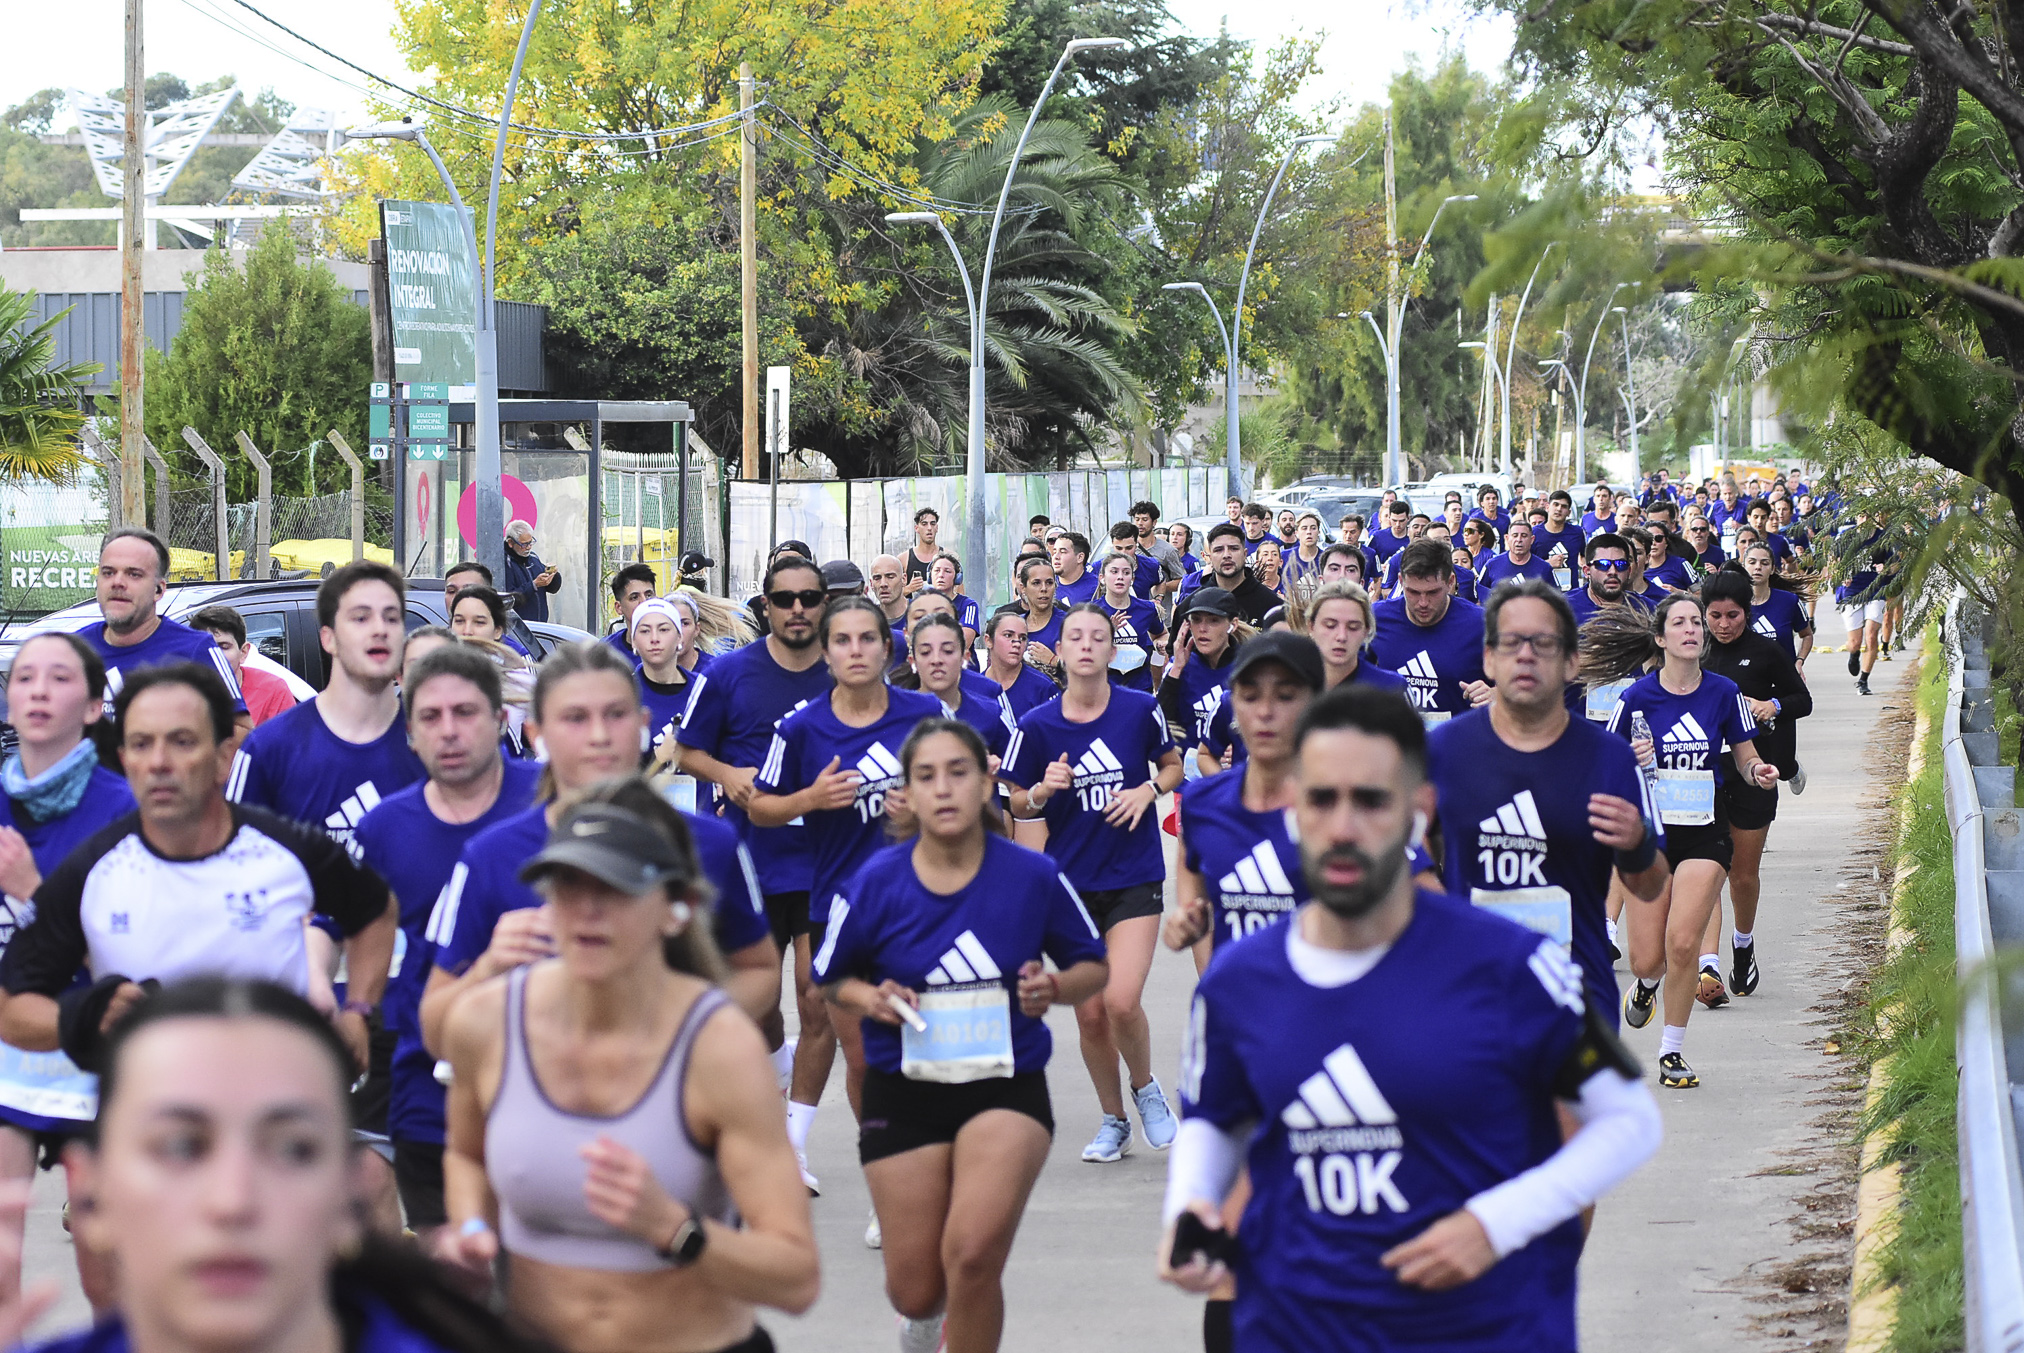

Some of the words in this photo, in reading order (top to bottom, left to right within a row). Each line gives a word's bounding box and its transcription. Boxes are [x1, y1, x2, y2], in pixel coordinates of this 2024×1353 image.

[391, 246, 449, 276] RENOVACIÓN
[393, 284, 436, 309] INTEGRAL
[375, 385, 384, 396] P
[10, 550, 69, 563] NUEVAS
[1662, 741, 1710, 753] SUPERNOVA
[1663, 752, 1709, 771] 10K
[1073, 771, 1124, 788] SUPERNOVA
[1673, 788, 1710, 802] A2553
[1478, 833, 1548, 854] SUPERNOVA
[1478, 849, 1548, 886] 10K
[1220, 893, 1297, 912] SUPERNOVA
[1224, 910, 1278, 942] 10
[932, 1018, 1002, 1045] A0102
[1288, 1125, 1404, 1155] SUPERNOVA
[1293, 1150, 1410, 1216] 10K
